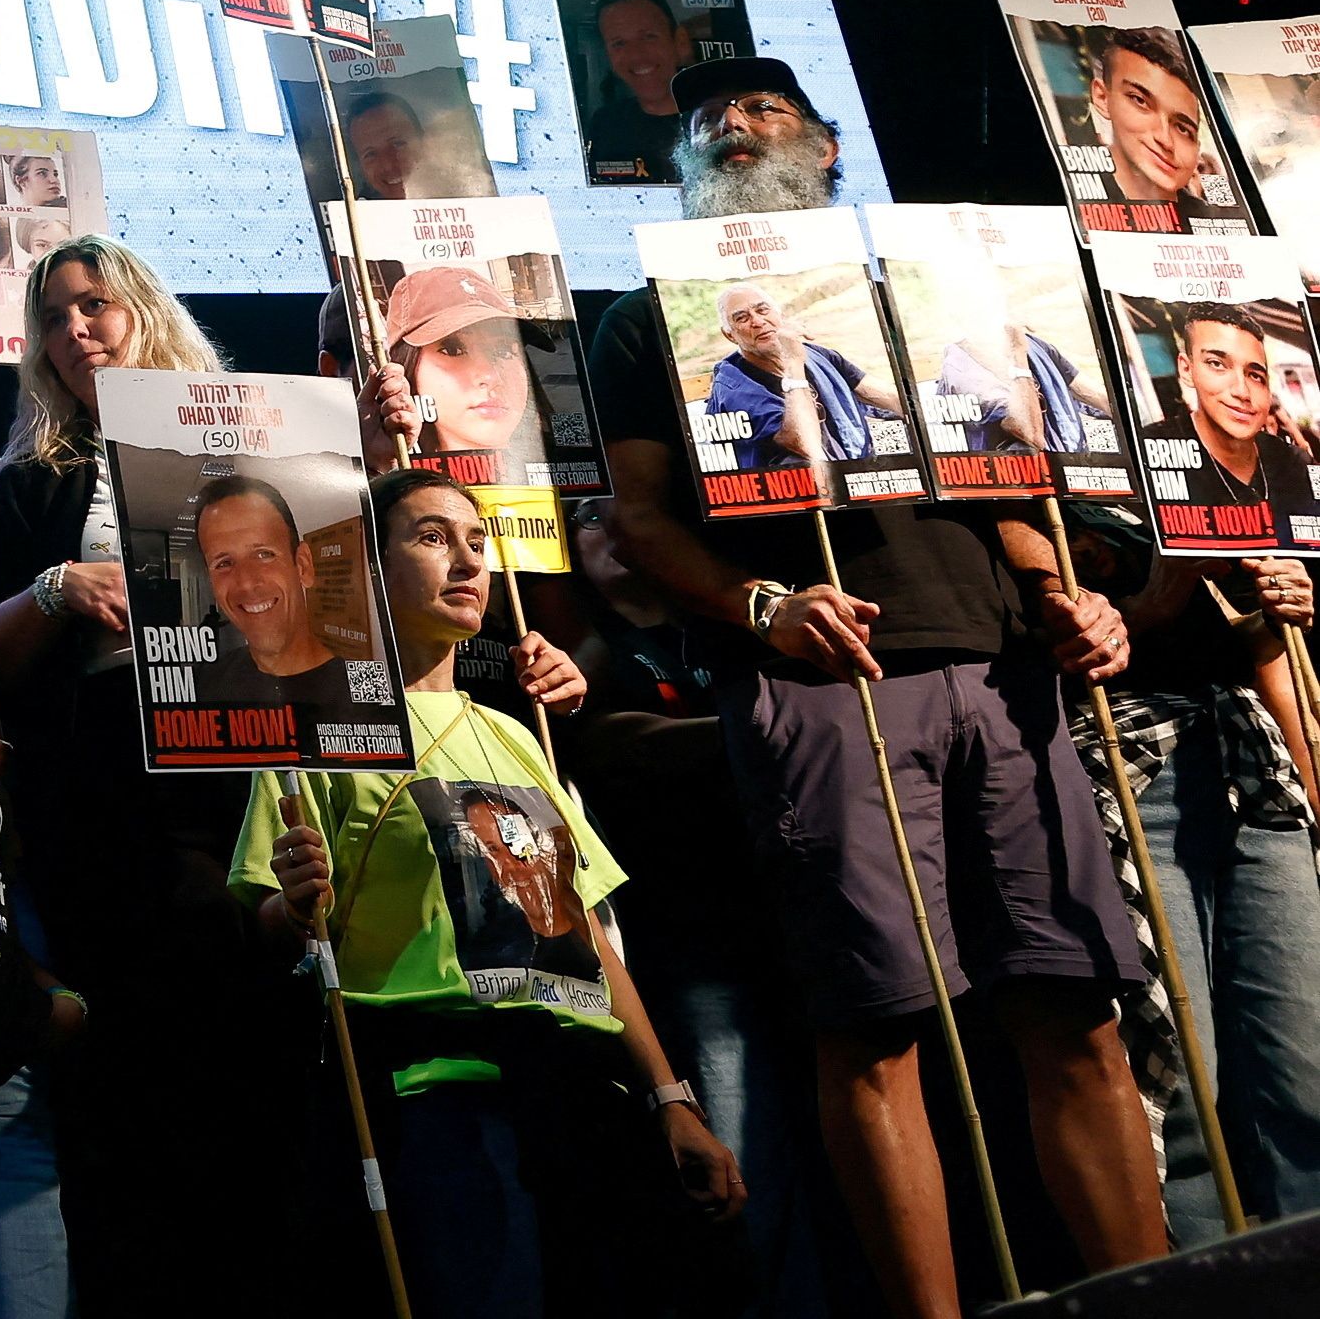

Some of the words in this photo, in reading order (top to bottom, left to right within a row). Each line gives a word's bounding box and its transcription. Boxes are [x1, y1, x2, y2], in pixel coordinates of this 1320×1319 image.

[699, 41, 735, 61] פדיון
[1281, 40, 1306, 54] ITAY
[348, 62, 374, 79] (50)
[1059, 145, 1115, 172] BRING
[1068, 172, 1108, 200] HIM
[413, 208, 442, 224] אלבג
[444, 206, 466, 223] לירי
[413, 225, 436, 241] LIRI
[438, 225, 474, 240] ALBAG
[422, 243, 451, 260] (19)
[717, 241, 746, 257] GADI
[749, 236, 788, 253] MOSES
[745, 255, 770, 272] (80)
[178, 406, 216, 426] OHAD
[218, 406, 286, 427] YAHALOMI
[203, 429, 239, 451] (50)
[1144, 438, 1202, 470] BRING
[1150, 470, 1190, 500] HIM
[1159, 505, 1213, 535] HOME
[1214, 502, 1275, 535] NOW!
[317, 723, 353, 736] HOSTAGES
[354, 724, 368, 736] AND
[368, 724, 400, 737] MISSING
[319, 736, 365, 754] FAMILIES
[367, 736, 403, 755] FORUM
[475, 972, 521, 1000] Bring
[530, 977, 559, 1001] Ohad
[570, 984, 609, 1011] Home
